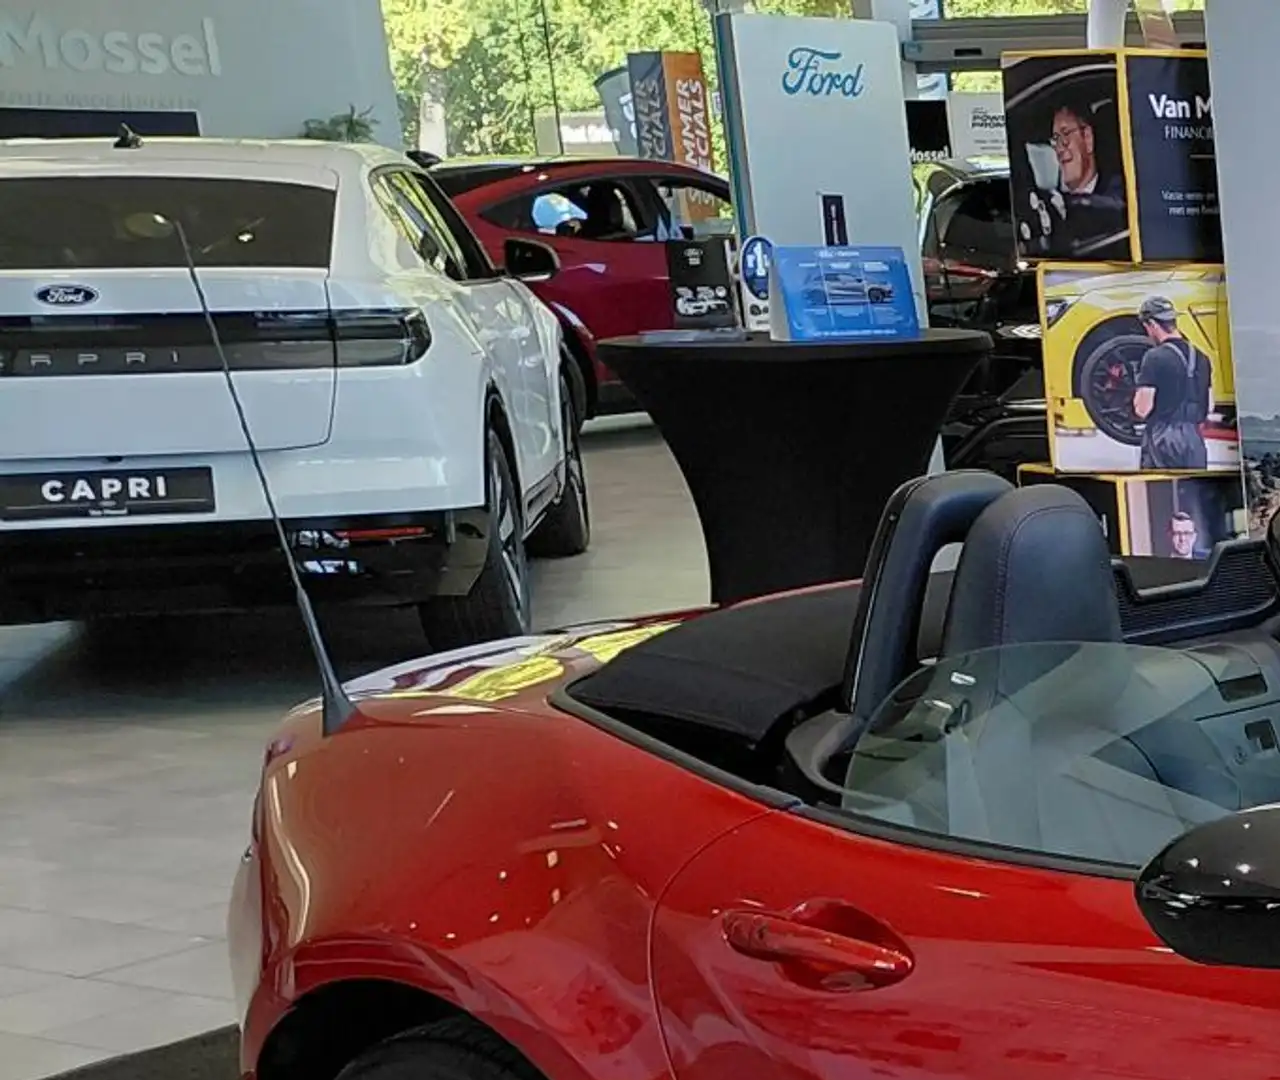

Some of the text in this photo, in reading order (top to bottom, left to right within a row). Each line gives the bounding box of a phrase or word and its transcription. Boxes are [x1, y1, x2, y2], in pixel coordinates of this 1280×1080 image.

[0, 10, 221, 76] Mossel
[782, 47, 863, 97] Ford
[1149, 94, 1190, 118] Van
[47, 288, 85, 303] Ford
[0, 351, 179, 368] APRI
[41, 476, 167, 501] CAPRI
